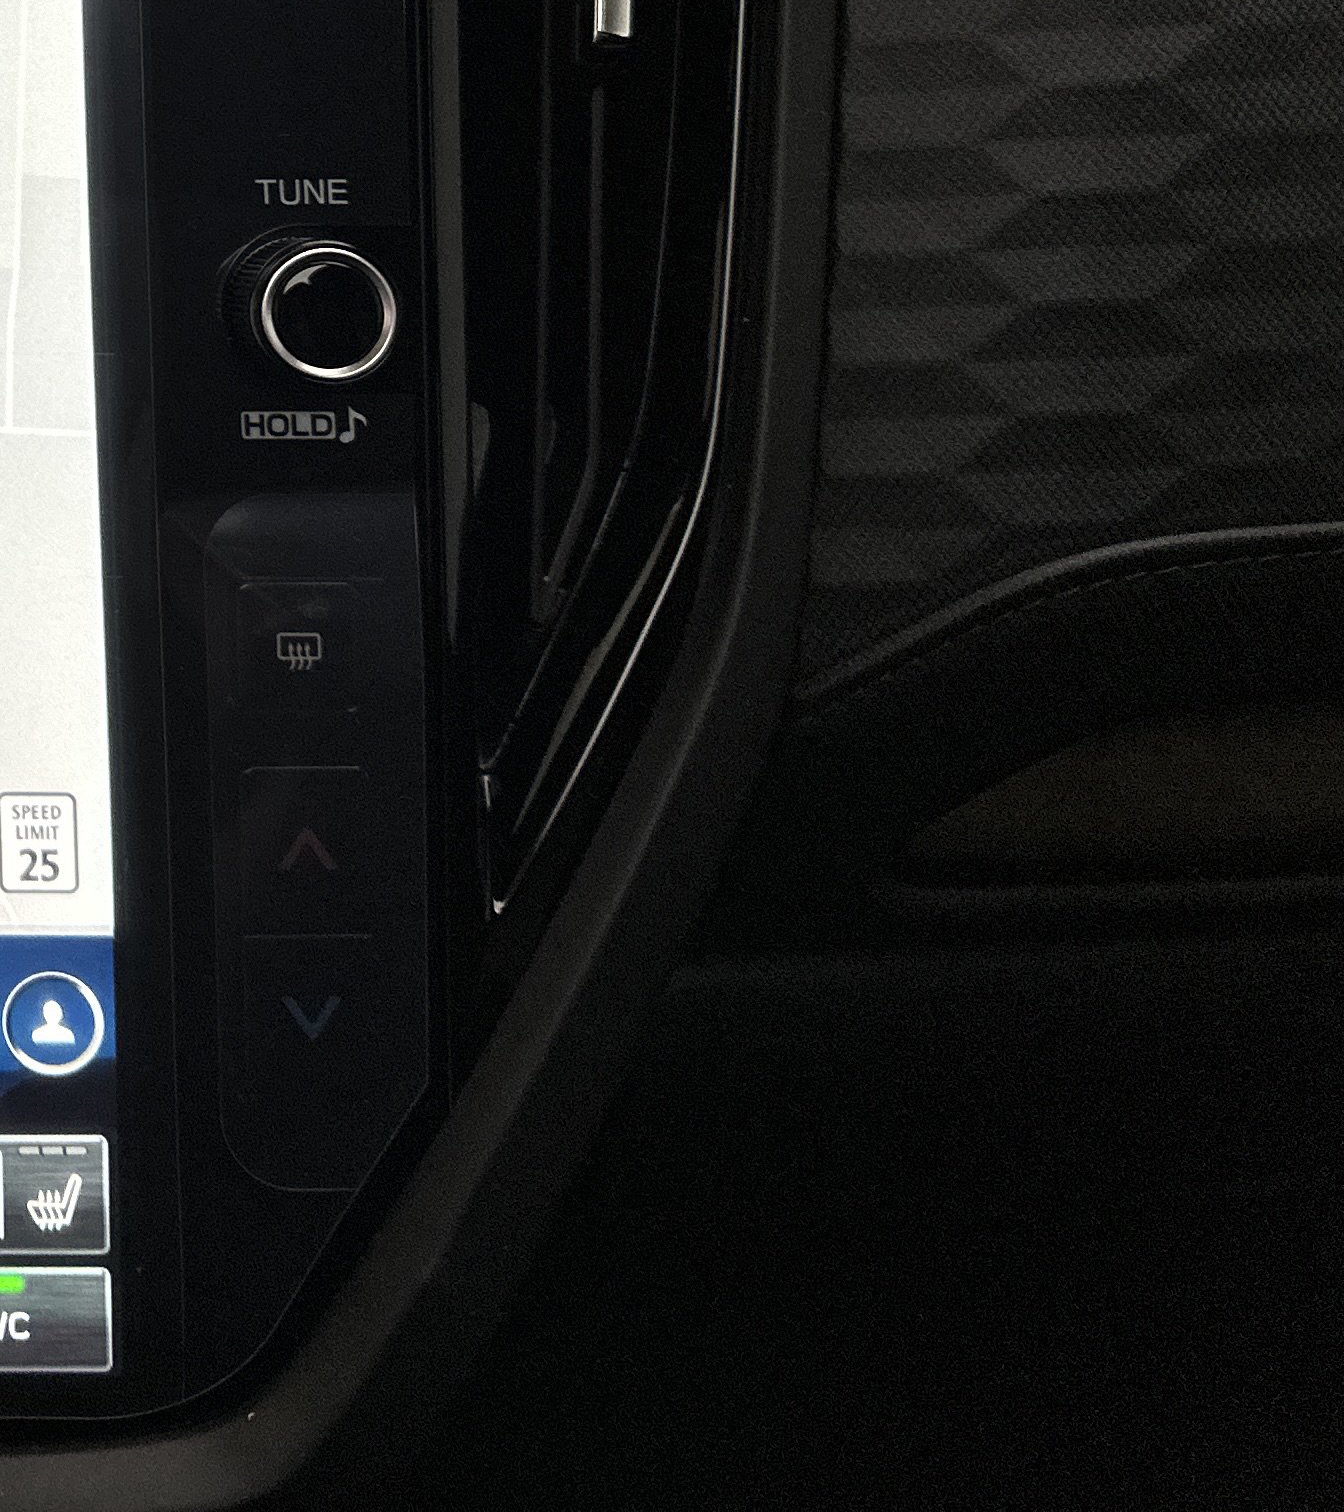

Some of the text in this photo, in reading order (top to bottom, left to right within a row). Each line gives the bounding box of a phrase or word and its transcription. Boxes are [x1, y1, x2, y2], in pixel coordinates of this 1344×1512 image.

[254, 178, 350, 206] TUNE
[242, 412, 336, 439] HOLD
[11, 804, 62, 821] SPEED
[15, 824, 60, 841] LIMIT
[19, 848, 60, 883] 25
